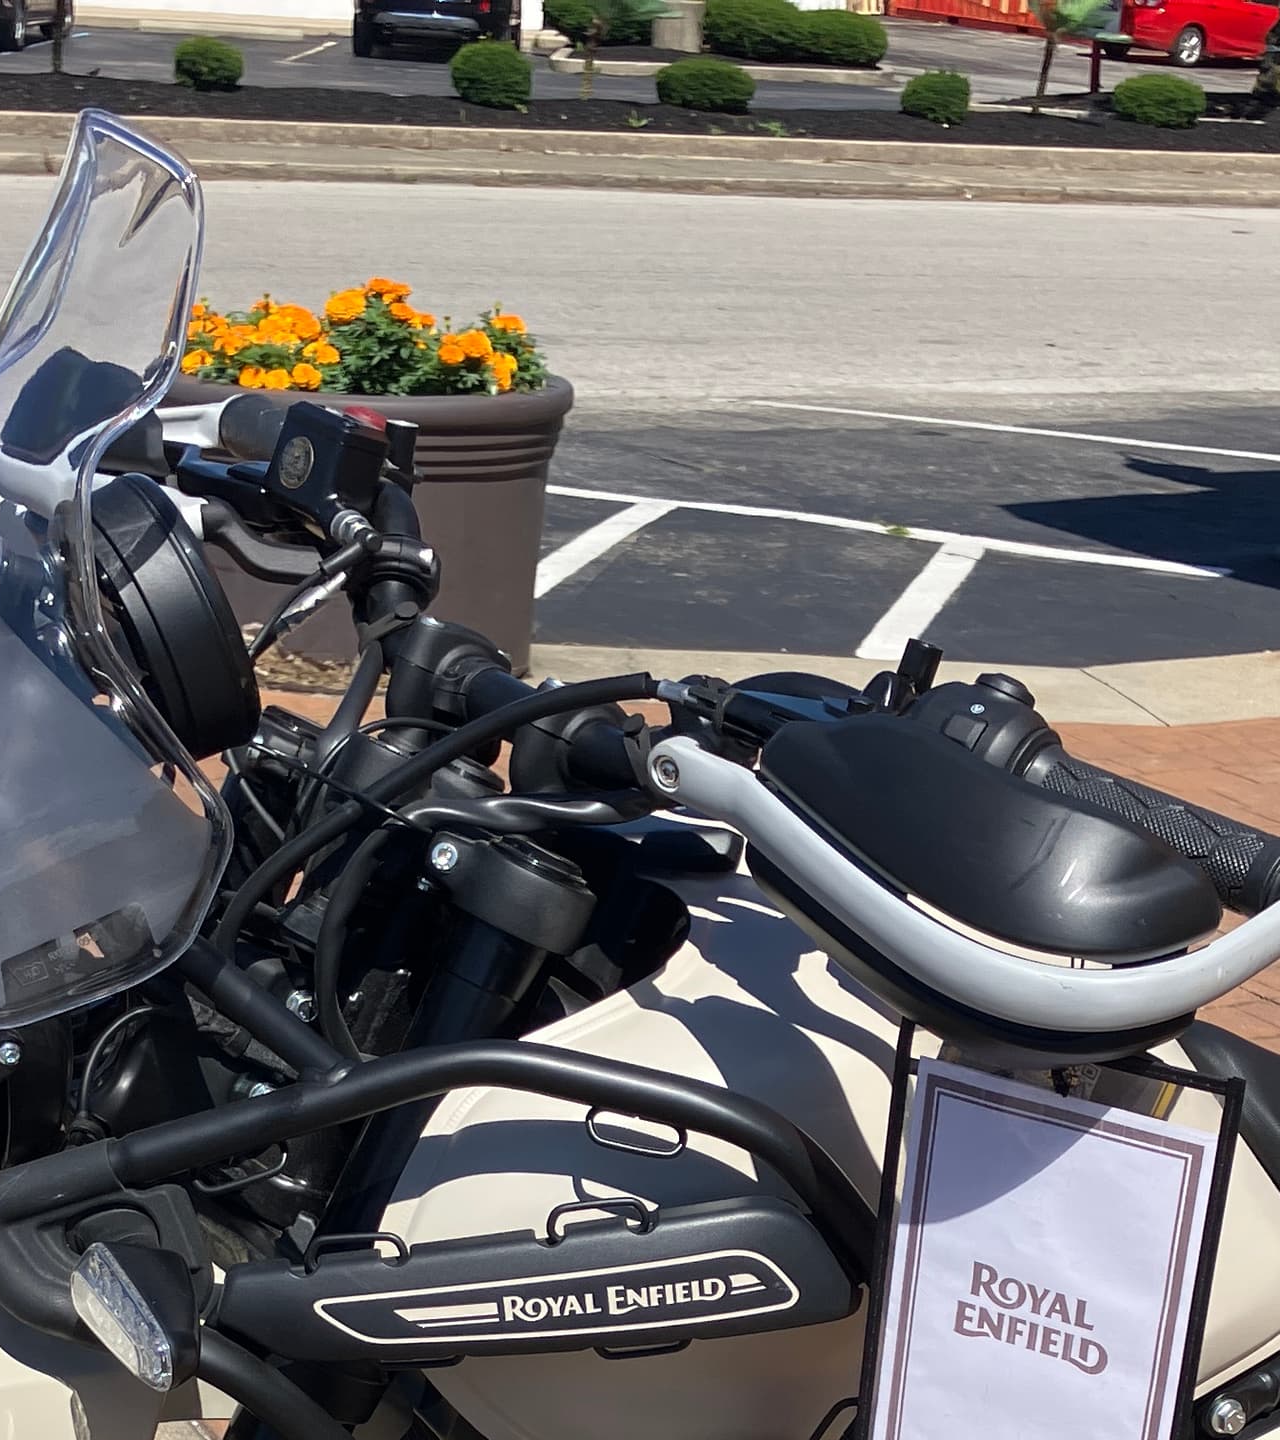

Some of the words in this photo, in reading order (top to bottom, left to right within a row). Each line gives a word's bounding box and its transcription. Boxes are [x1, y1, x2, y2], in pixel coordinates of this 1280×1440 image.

[502, 1289, 603, 1323] ROYAL
[606, 1273, 727, 1317] ENFIELD
[969, 1260, 1094, 1332] ROYAL
[953, 1299, 1109, 1376] ENFIELD
